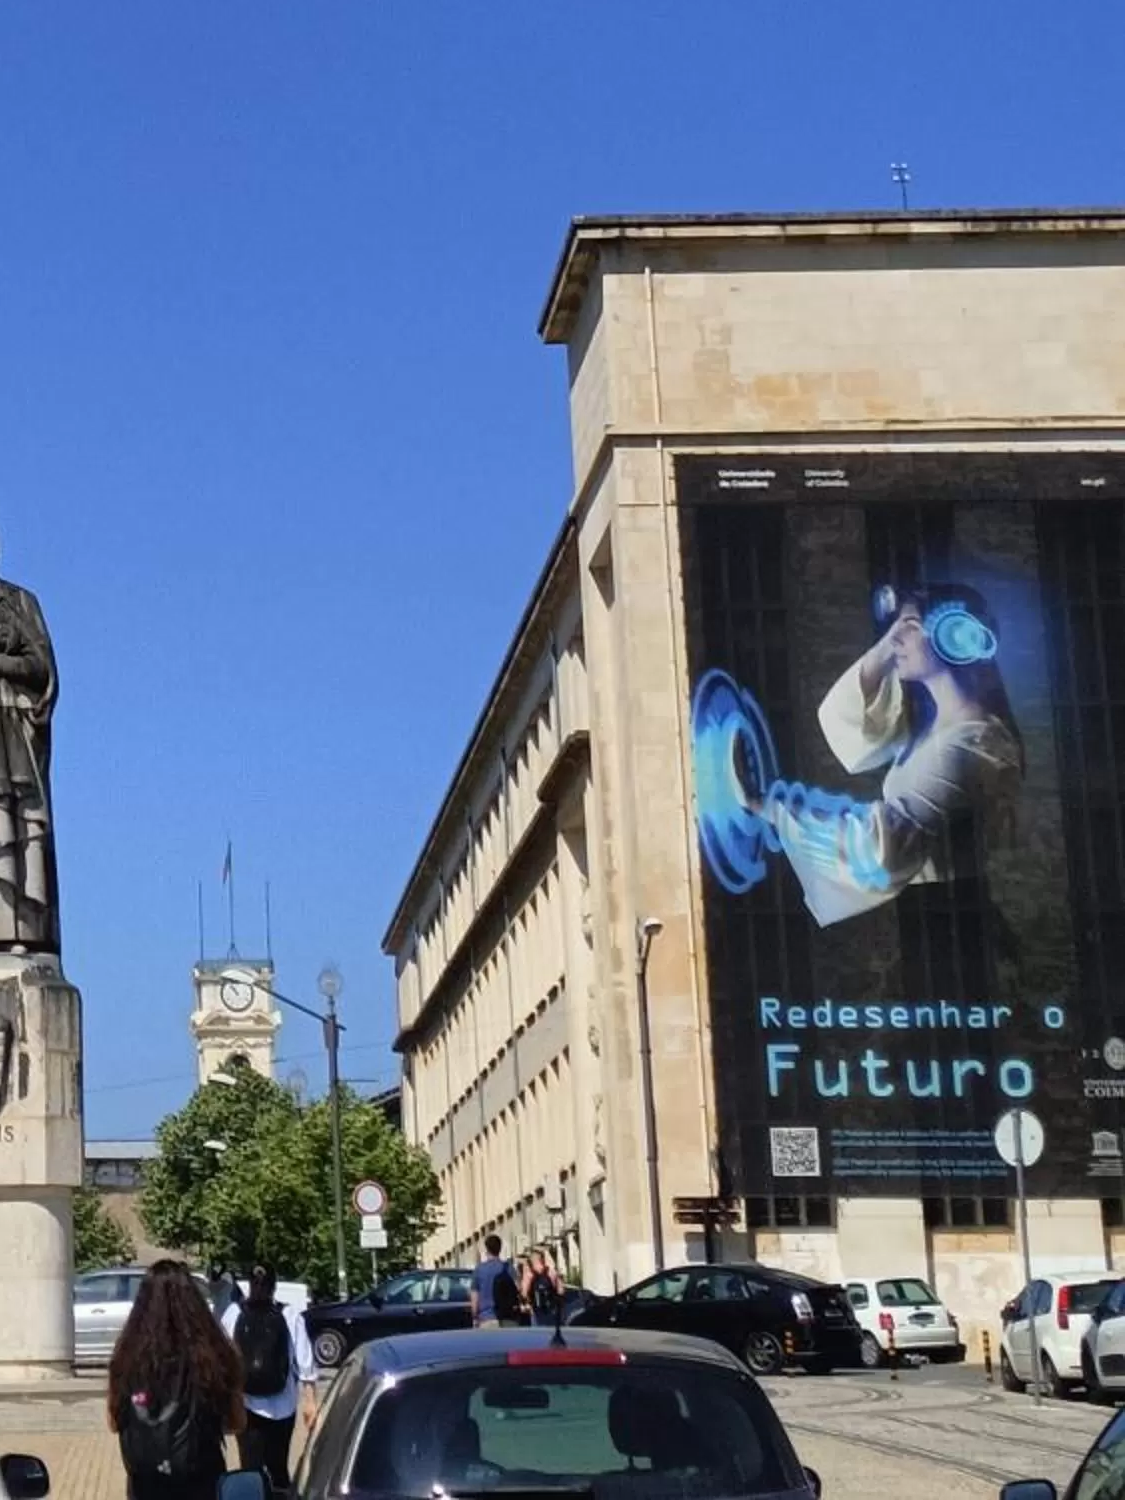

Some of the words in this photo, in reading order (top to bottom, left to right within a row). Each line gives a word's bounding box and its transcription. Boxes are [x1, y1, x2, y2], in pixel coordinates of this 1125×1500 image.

[760, 997, 1012, 1029] Redesenhar
[1044, 1006, 1065, 1029] o
[766, 1043, 1035, 1097] Futuro
